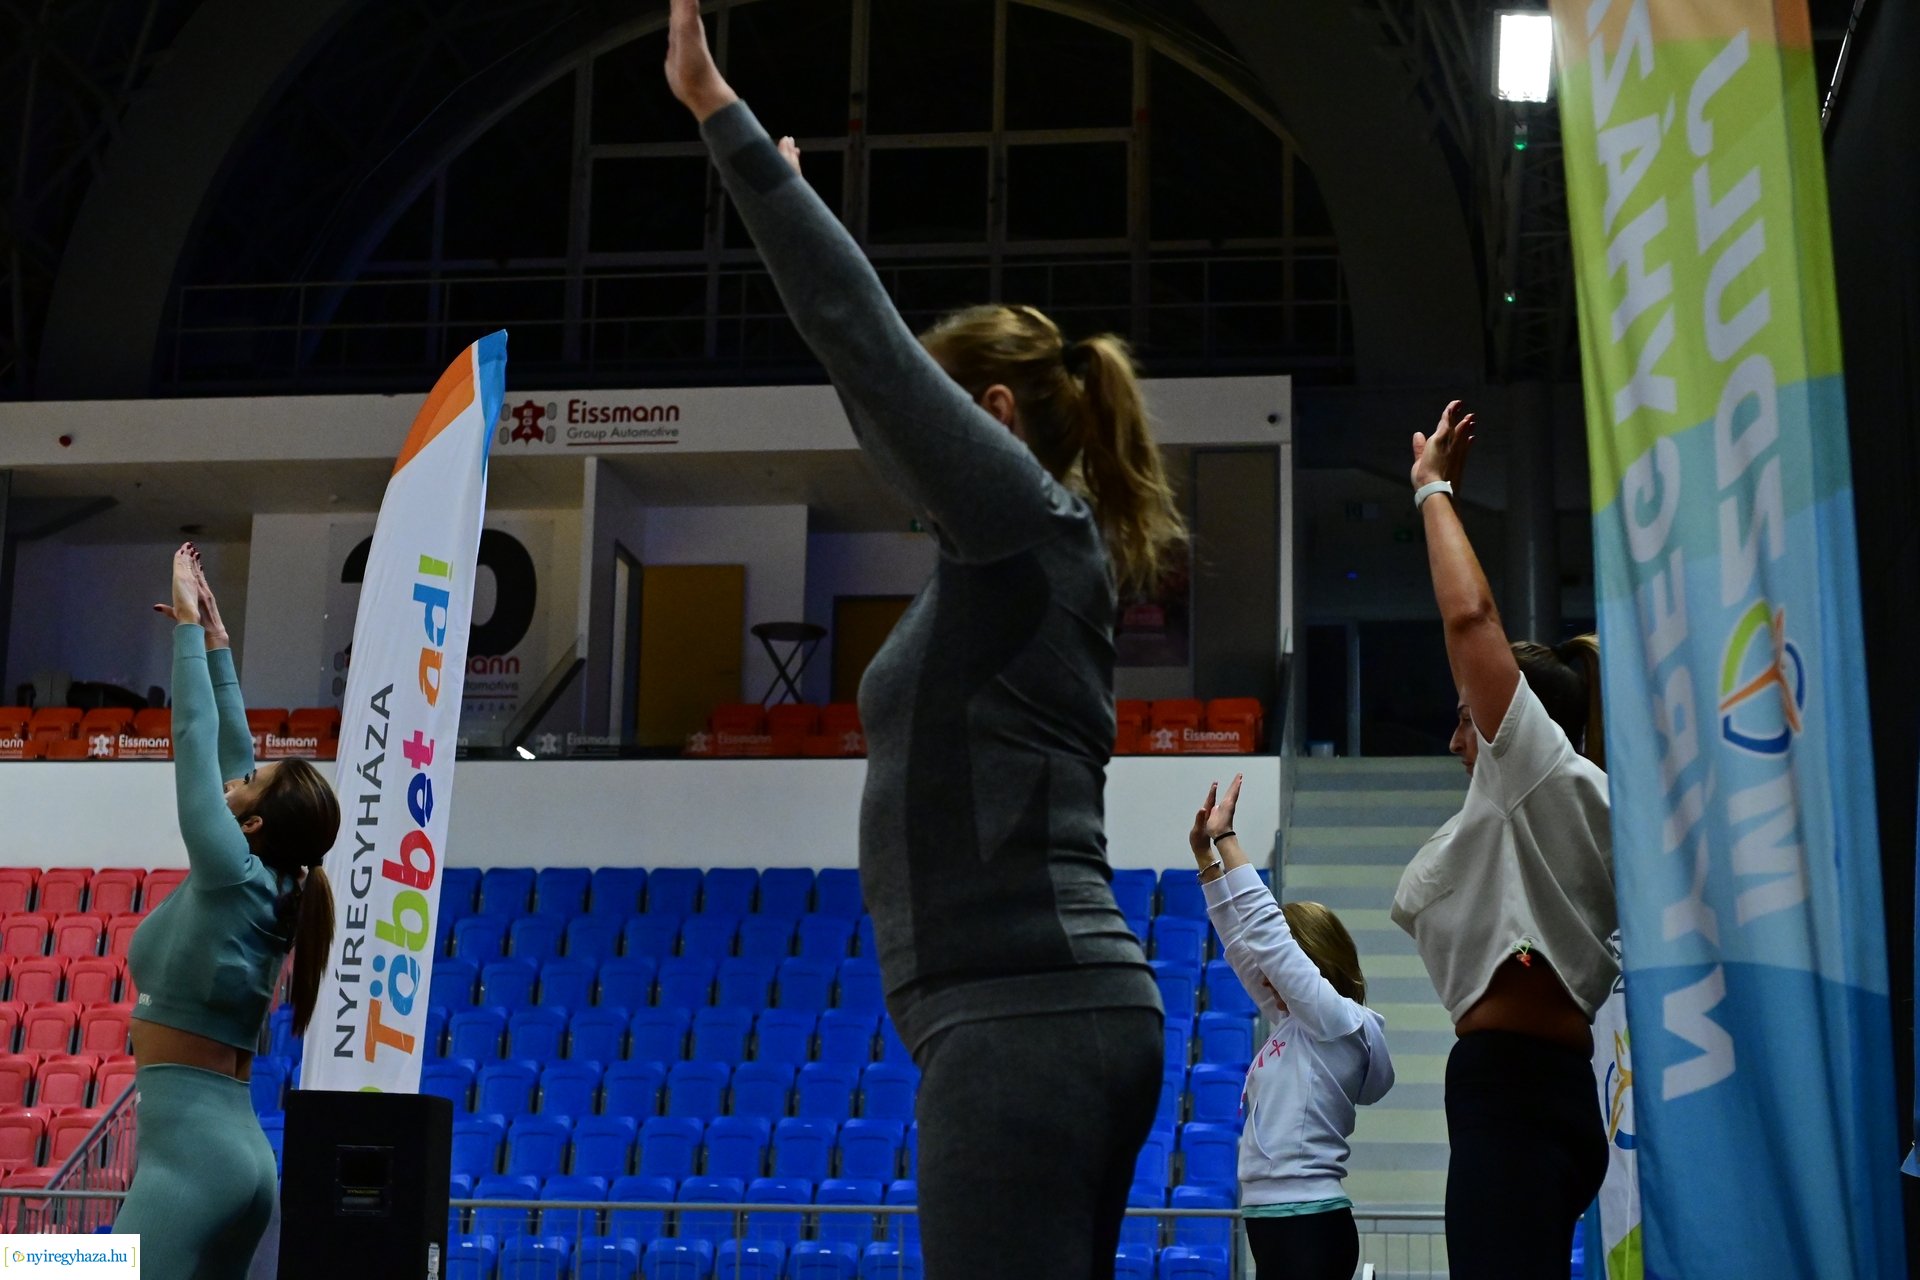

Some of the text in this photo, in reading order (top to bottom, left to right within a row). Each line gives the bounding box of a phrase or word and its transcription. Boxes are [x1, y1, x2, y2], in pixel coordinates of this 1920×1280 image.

[567, 399, 680, 424] Eissmann
[566, 426, 679, 440] Group Automotive
[118, 733, 169, 749] Eissmann
[265, 733, 317, 748] Eissmann
[1183, 728, 1240, 742] Eissmann
[334, 683, 395, 1059] NYÍREGYHÁZA
[364, 730, 437, 1063] Többet
